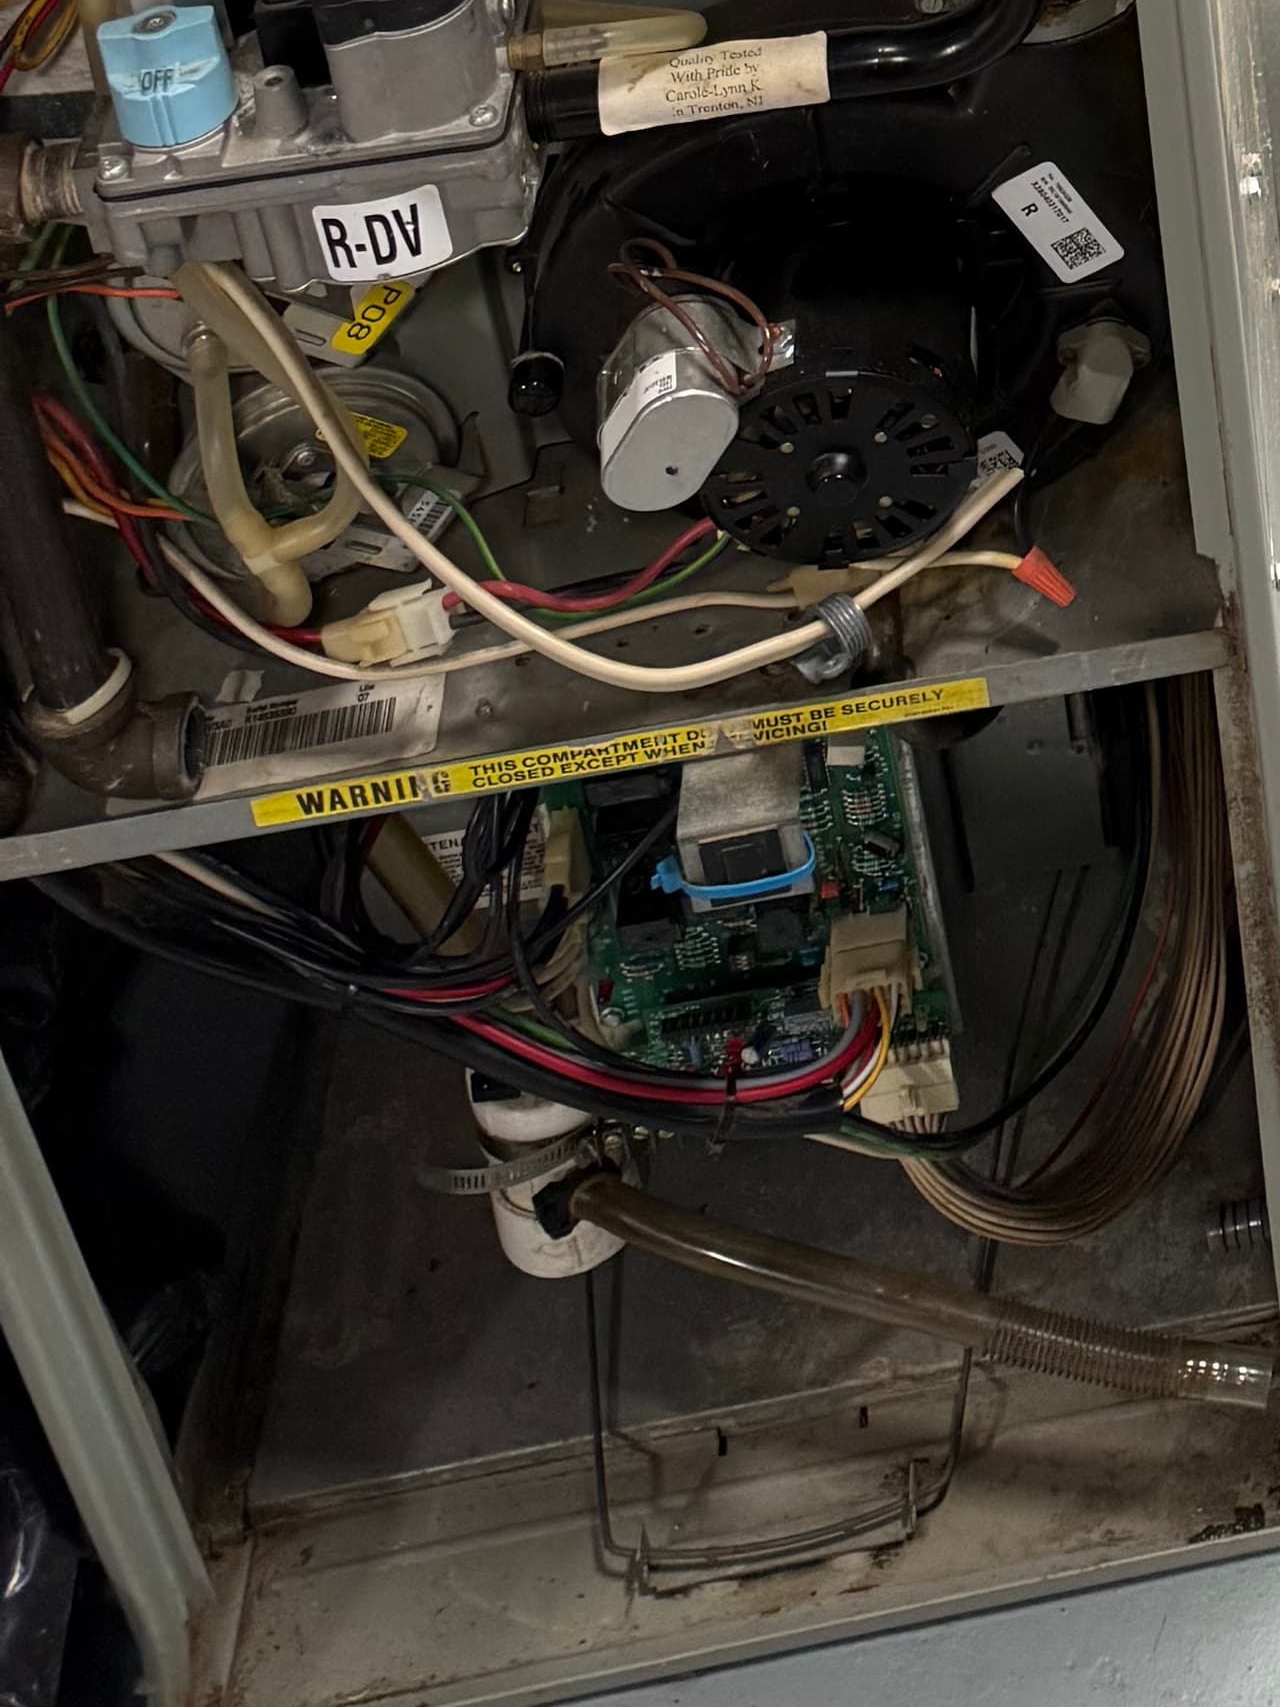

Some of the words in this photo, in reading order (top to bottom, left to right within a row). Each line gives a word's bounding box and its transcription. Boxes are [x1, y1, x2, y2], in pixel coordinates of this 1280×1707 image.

[668, 52, 714, 69] Quality
[720, 46, 763, 61] Tested
[671, 70, 703, 84] With
[707, 64, 741, 81] Pride
[139, 67, 174, 93] OFF
[1021, 202, 1039, 217] R
[320, 203, 422, 268] R-DV
[347, 285, 403, 342] P08
[468, 759, 518, 777] THIS
[521, 730, 681, 768] COMPARTMENT
[752, 711, 805, 731] MUST
[809, 706, 836, 722] BE
[840, 688, 945, 717] SECURELY
[471, 765, 555, 789] CLOSED
[560, 751, 643, 776] EXCEPT
[645, 742, 706, 762] WHEN
